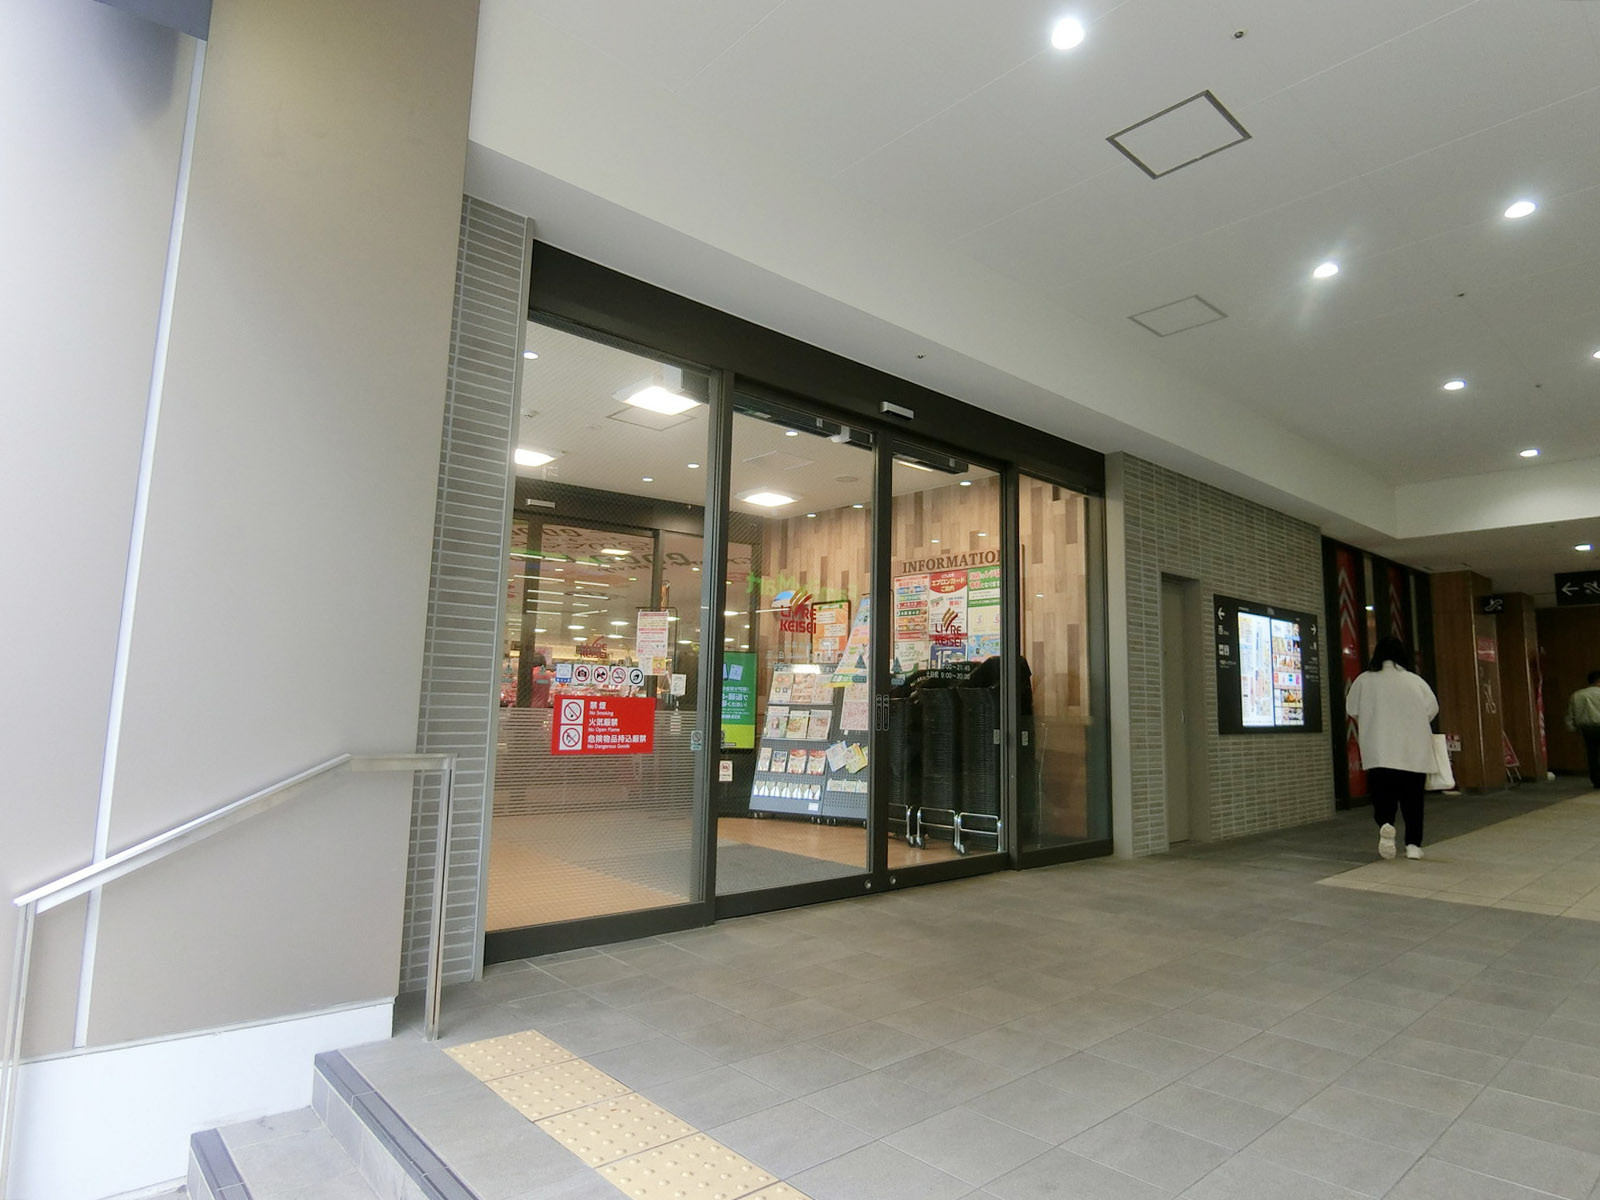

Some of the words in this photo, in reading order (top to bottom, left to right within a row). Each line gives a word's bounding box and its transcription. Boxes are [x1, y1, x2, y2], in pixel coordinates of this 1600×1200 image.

[780, 620, 816, 634] KEISEI
[935, 637, 962, 648] KEISEI
[590, 701, 606, 709] 禁煙
[588, 735, 646, 743] 危険物品持込厳禁
